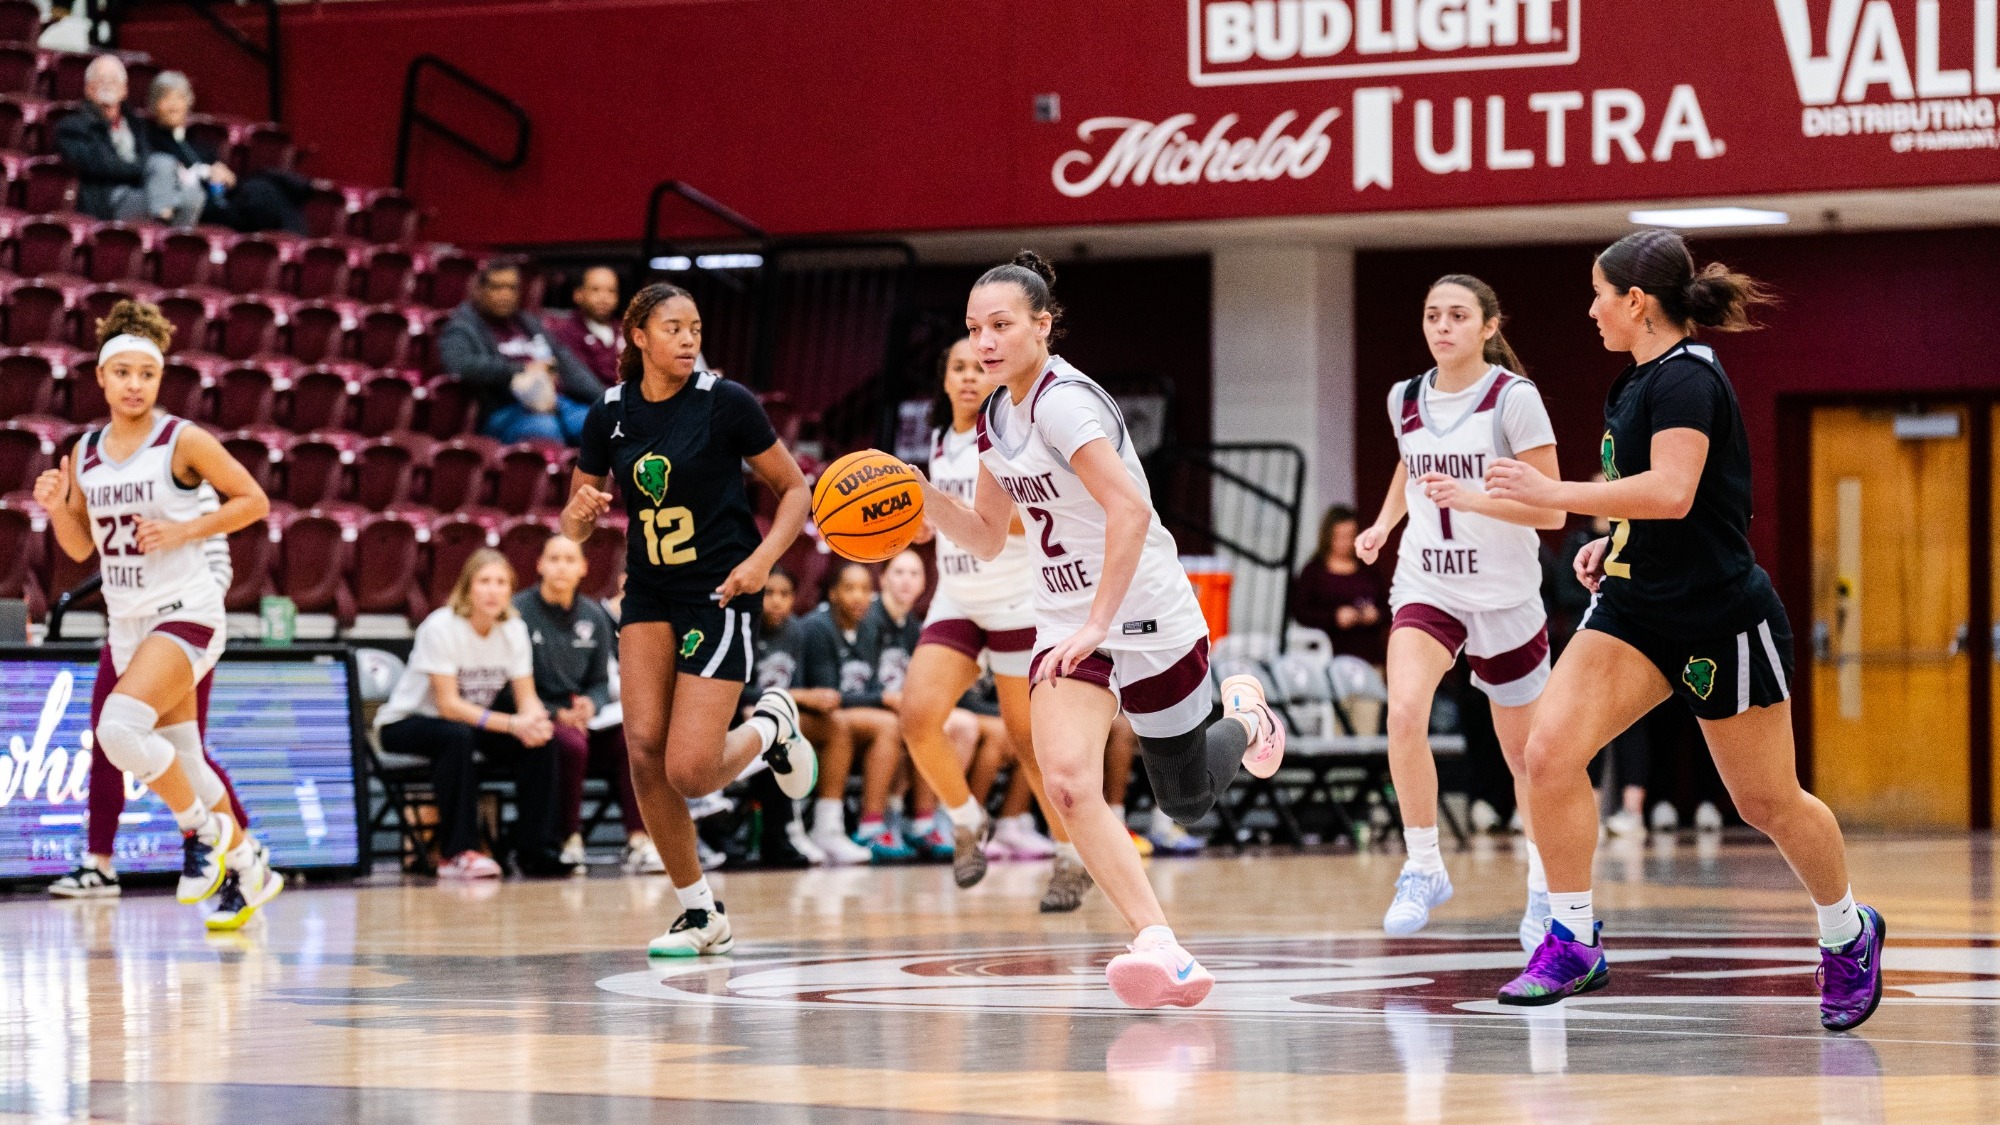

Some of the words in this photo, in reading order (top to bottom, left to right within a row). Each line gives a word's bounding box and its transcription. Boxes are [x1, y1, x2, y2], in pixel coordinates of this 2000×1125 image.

[1206, 0, 1352, 64] BUD
[1802, 97, 1995, 138] DISTRIBUTING
[1052, 107, 1342, 197] Michelob
[1413, 84, 1713, 174] ULTRA
[835, 464, 906, 496] Wilson
[1404, 453, 1486, 480] AIRMONT
[861, 491, 912, 523] NCAA
[1439, 507, 1454, 540] 1
[96, 513, 146, 557] 23
[638, 505, 698, 566] 12
[1027, 506, 1067, 558] 2
[1041, 559, 1092, 594] STATE
[1421, 549, 1479, 574] STATE
